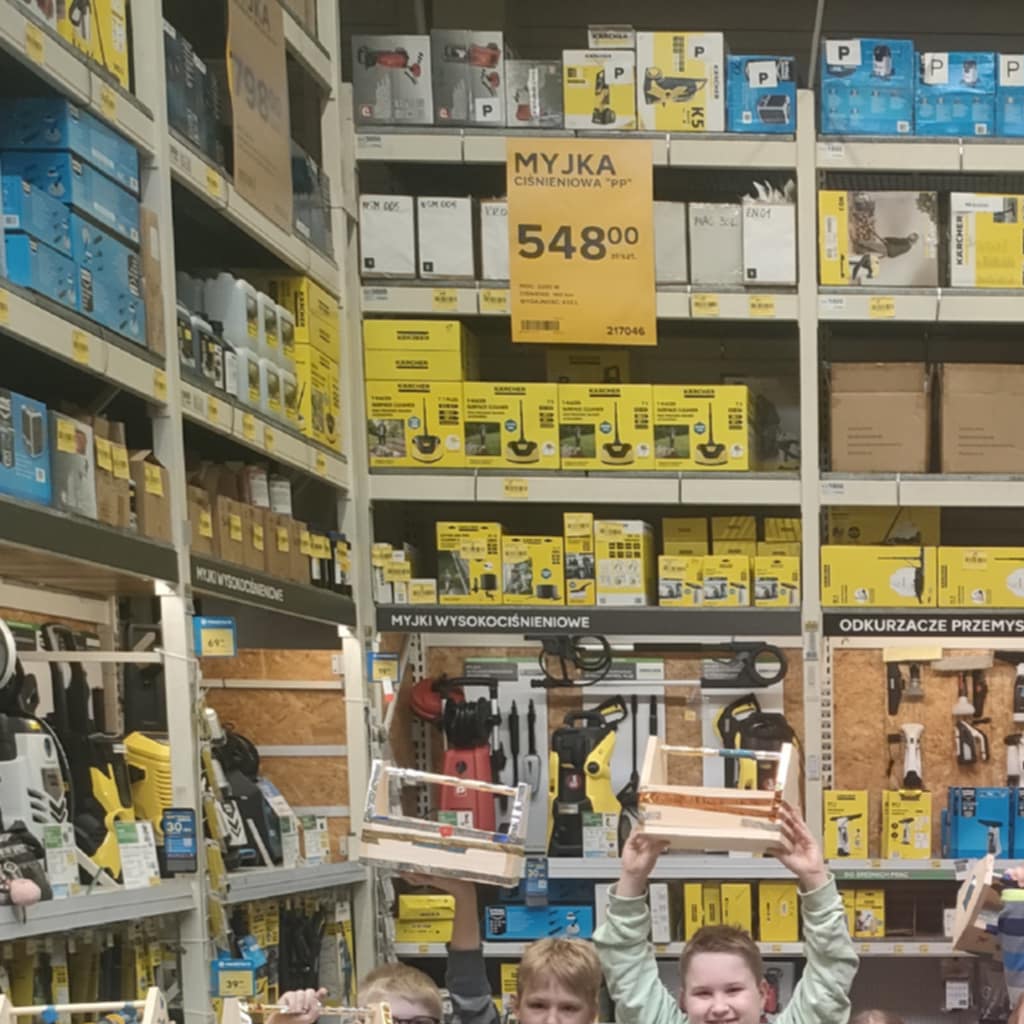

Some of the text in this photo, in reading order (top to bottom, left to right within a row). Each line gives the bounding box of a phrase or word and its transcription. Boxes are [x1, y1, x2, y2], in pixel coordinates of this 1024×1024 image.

[694, 46, 705, 58] P
[838, 47, 850, 60] P
[614, 67, 625, 79] P
[930, 59, 944, 76] P
[1007, 61, 1020, 77] P
[759, 72, 769, 84] P
[481, 104, 493, 117] P
[514, 152, 616, 176] MYJKA
[514, 175, 601, 188] CIŚNIENIOWA
[518, 224, 639, 261] 548 00
[607, 326, 646, 336] 217046
[391, 613, 591, 629] MYJKI WYSOKOCIŚNIENIOWE
[839, 618, 947, 632] ODKURZACZE
